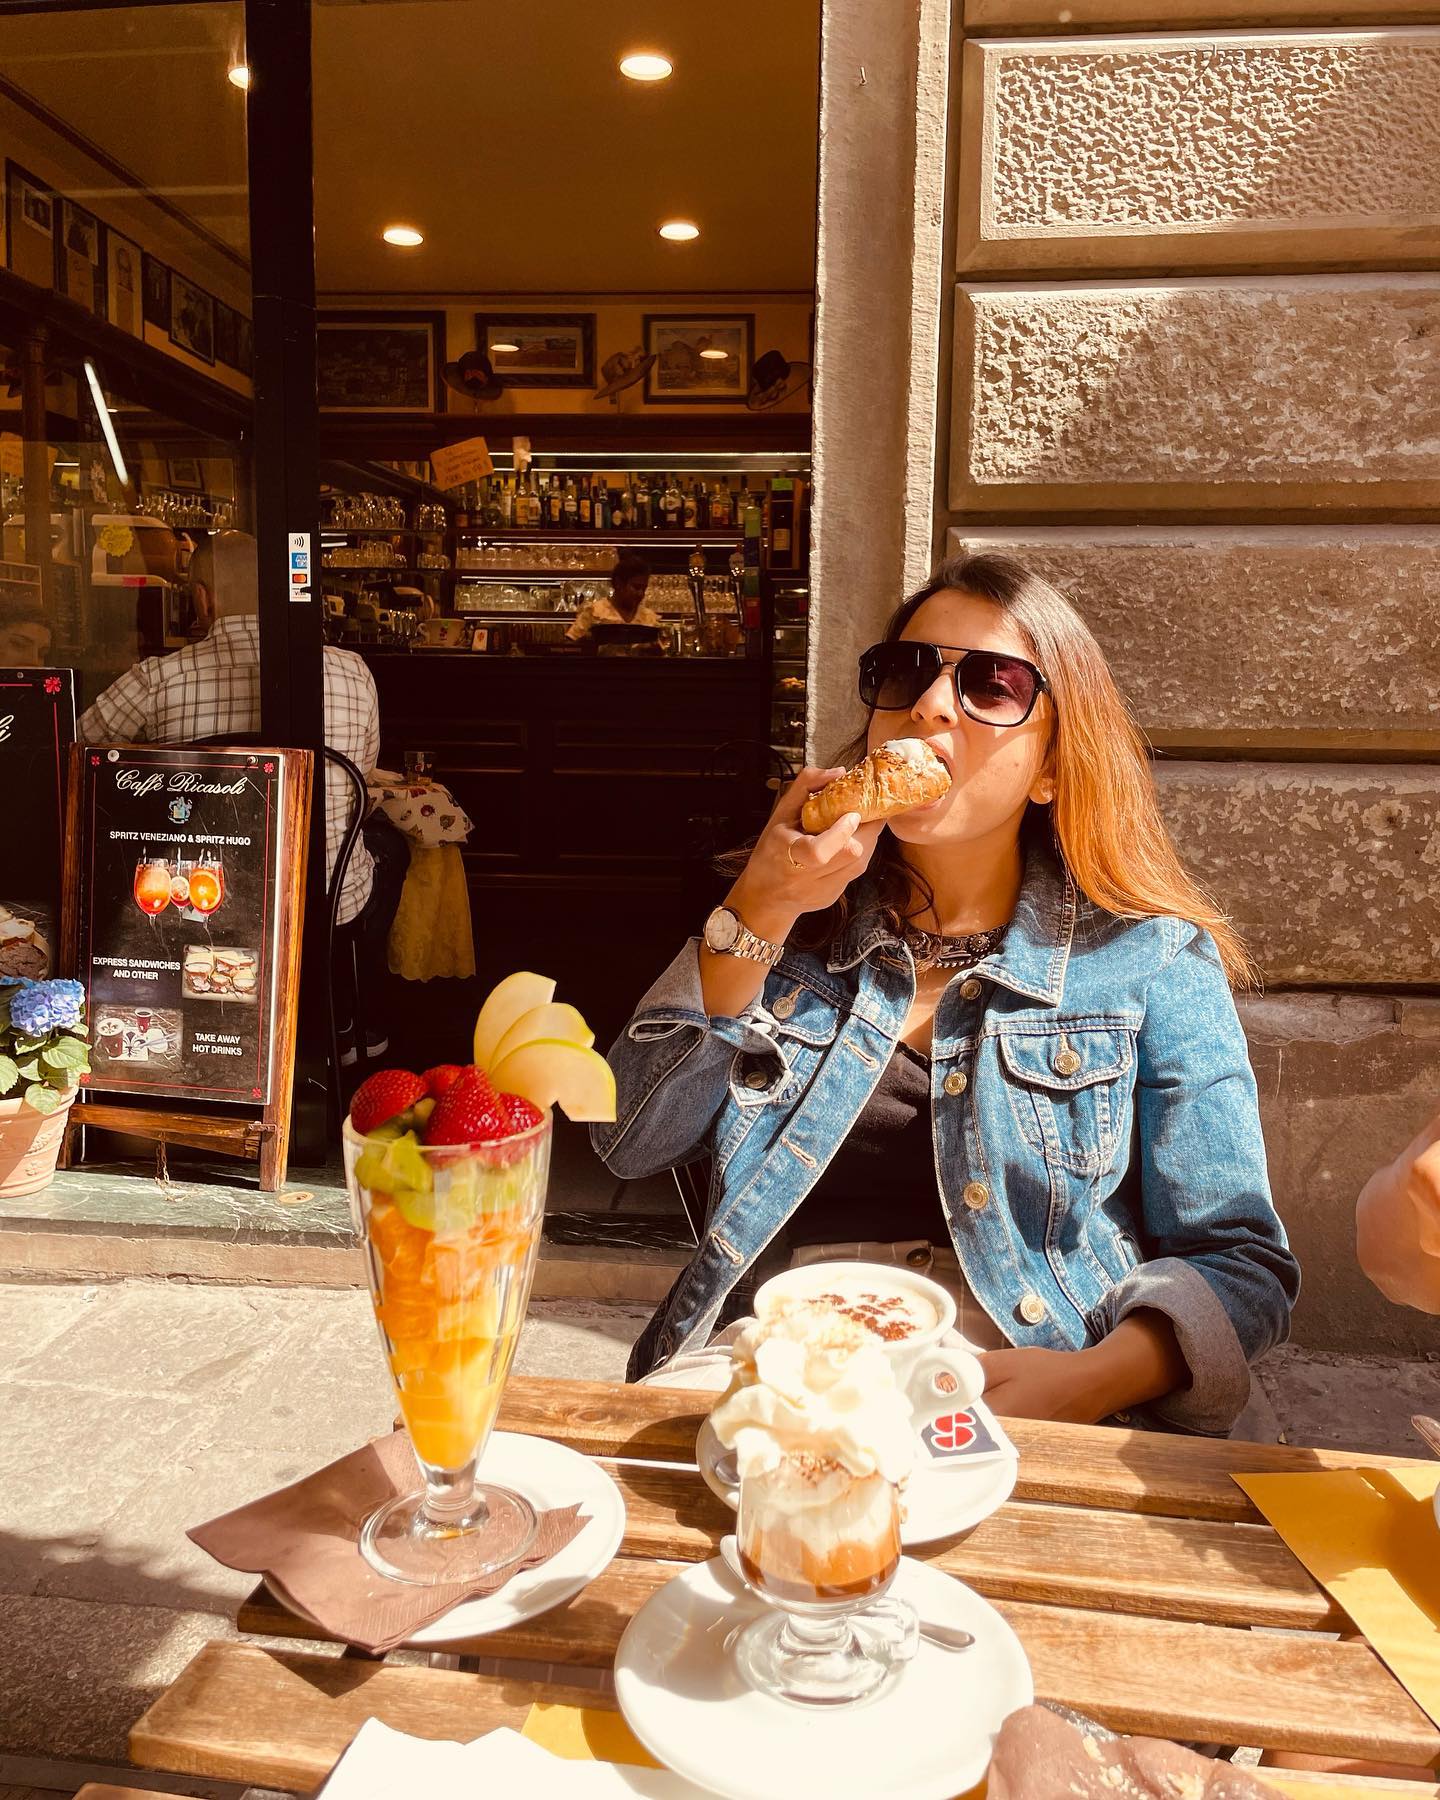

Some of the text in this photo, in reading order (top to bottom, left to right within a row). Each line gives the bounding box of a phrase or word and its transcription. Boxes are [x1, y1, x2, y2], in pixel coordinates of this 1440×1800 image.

[115, 769, 247, 796] Caffè Ricasoli
[109, 831, 138, 840] SPRITZ
[140, 832, 187, 843] VENEZIANO
[195, 835, 225, 844] SPRITZ
[226, 836, 251, 846] HUGO
[92, 956, 181, 971] EXPRESS SANDWICHES
[112, 969, 159, 981] AND OTHER
[194, 1032, 241, 1045] TAKE AWAY
[192, 1043, 243, 1056] HOT DRINKS
